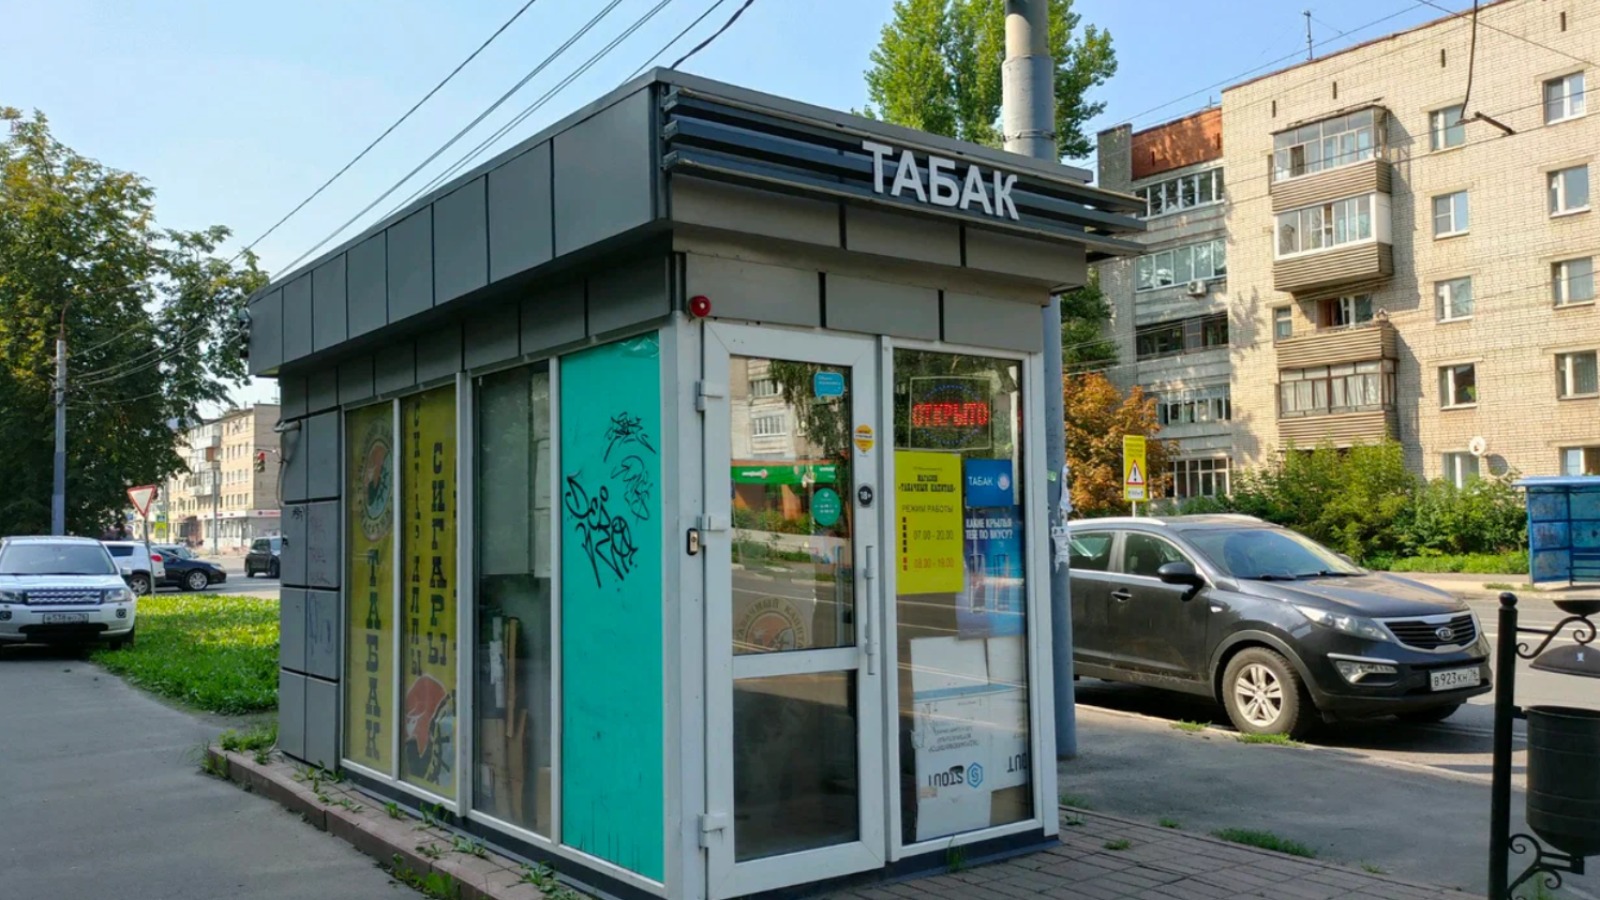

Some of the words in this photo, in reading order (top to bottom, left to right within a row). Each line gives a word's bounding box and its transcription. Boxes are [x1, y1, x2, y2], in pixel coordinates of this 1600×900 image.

[862, 141, 1020, 221] ТАБАК
[912, 402, 988, 428] ОТКРЫТО
[968, 475, 993, 487] ТАБАК
[428, 442, 447, 666] СИГАРЫ
[365, 549, 381, 761] ТАБАК
